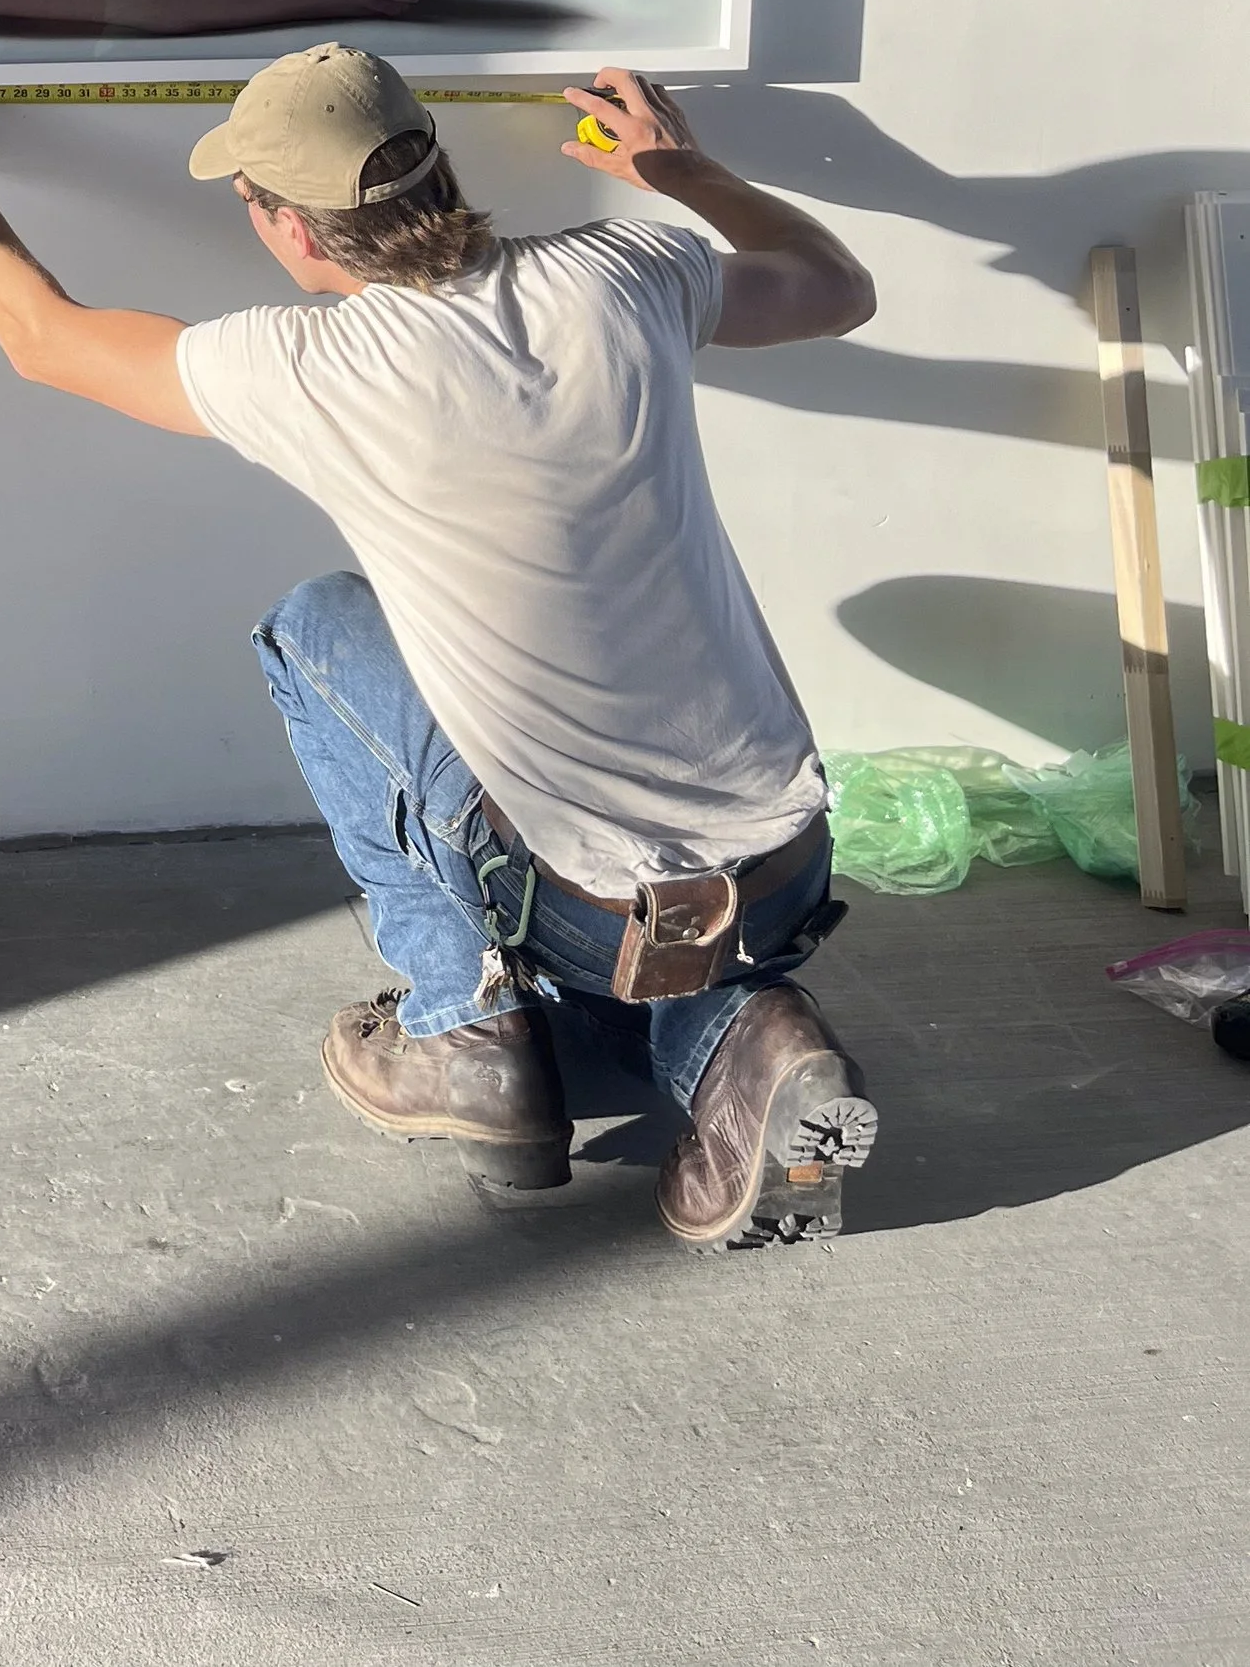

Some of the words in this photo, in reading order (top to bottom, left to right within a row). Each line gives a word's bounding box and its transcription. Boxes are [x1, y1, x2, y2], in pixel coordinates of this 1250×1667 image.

[13, 88, 28, 98] 28
[35, 88, 50, 98] 29
[57, 88, 71, 98] 30
[78, 88, 90, 98] 31
[122, 88, 136, 98] 33
[143, 88, 158, 97] 34
[164, 88, 179, 97] 35
[186, 88, 201, 97] 36
[208, 88, 222, 97] 37
